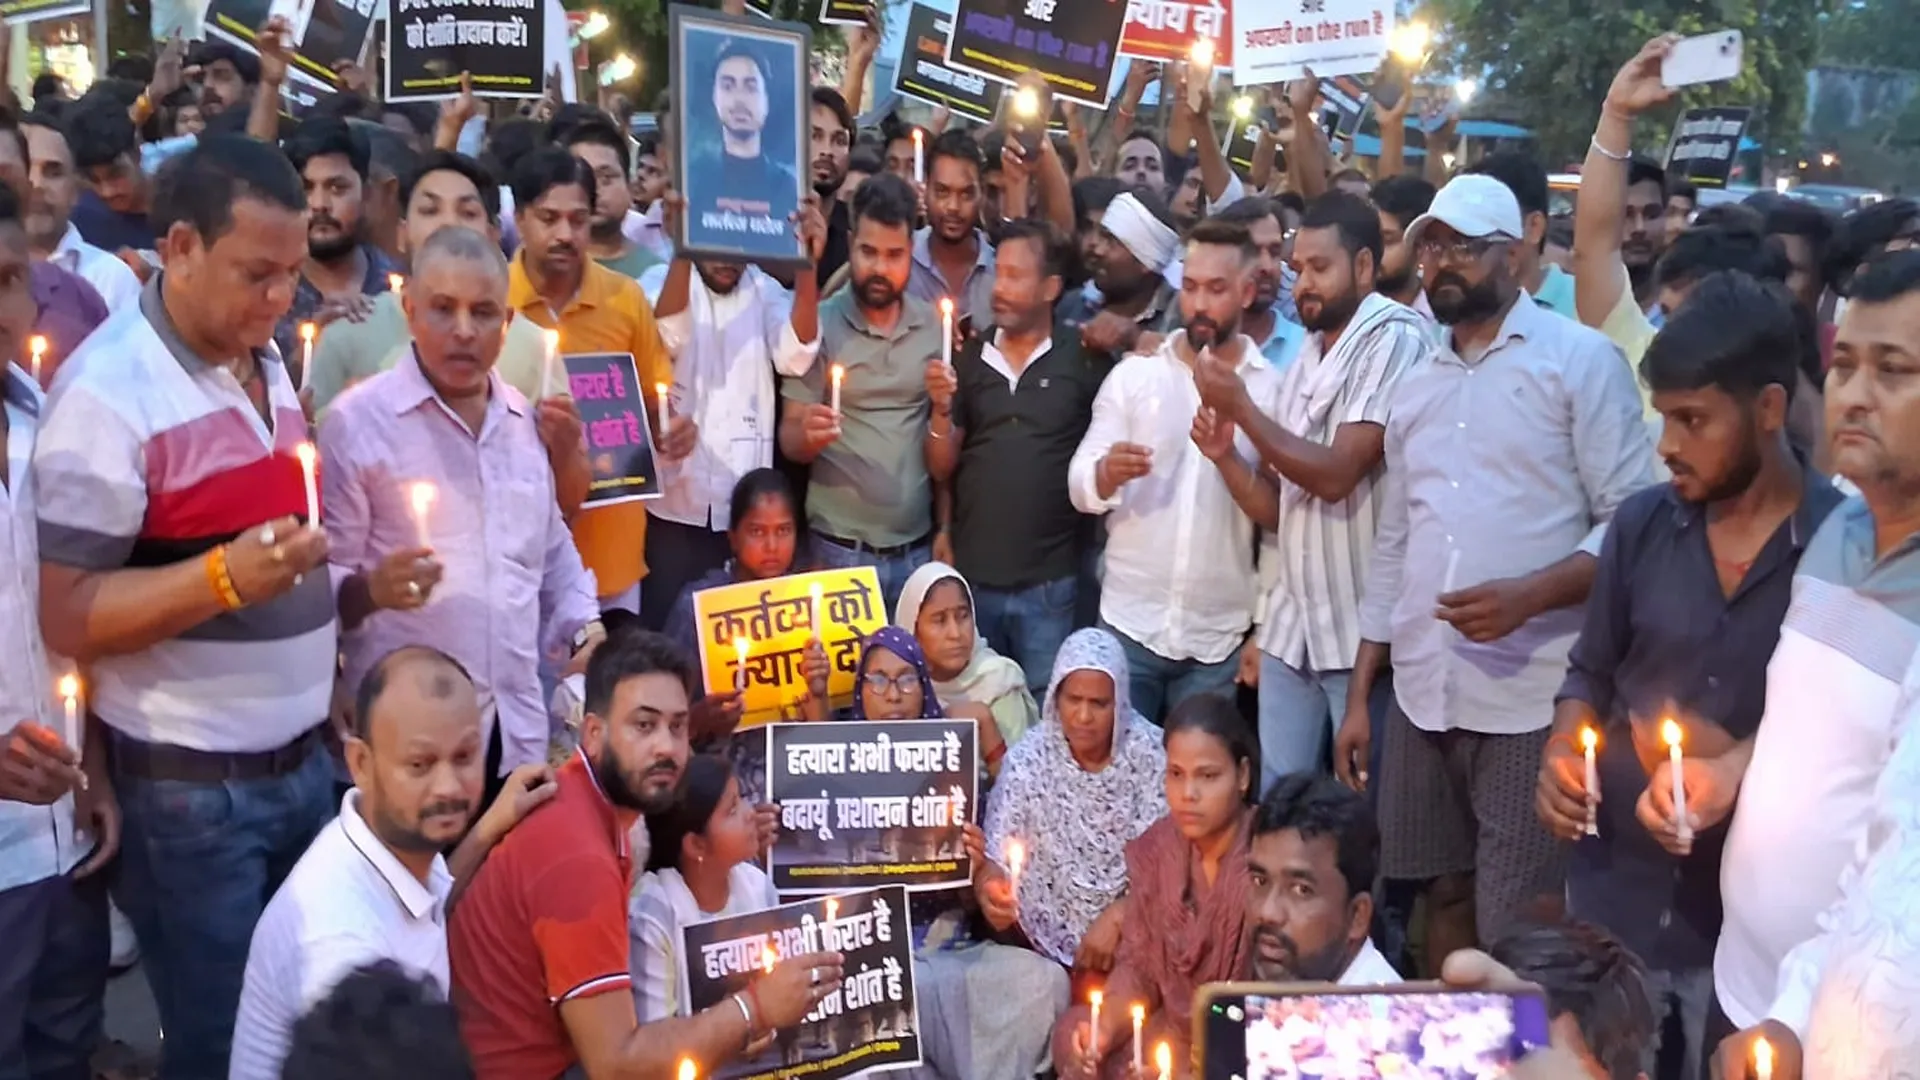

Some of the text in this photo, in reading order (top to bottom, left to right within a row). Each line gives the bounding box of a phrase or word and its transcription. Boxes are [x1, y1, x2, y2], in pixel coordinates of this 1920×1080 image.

[405, 17, 424, 48] को
[426, 14, 456, 47] शांति
[457, 20, 494, 45] प्रदान
[1295, 26, 1314, 43] on
[1317, 20, 1341, 41] the
[1345, 19, 1370, 37] run
[1372, 10, 1384, 35] है
[608, 363, 626, 398] है
[590, 412, 627, 447] शांत
[622, 409, 641, 444] है
[708, 577, 873, 646] कर्तव्य को
[785, 730, 962, 775] हत्यारा अभी फरार है
[780, 785, 968, 841] बदायूं प्रशासन शांत है
[872, 898, 892, 942] है
[845, 963, 885, 1011] शांत
[882, 957, 903, 1000] है
